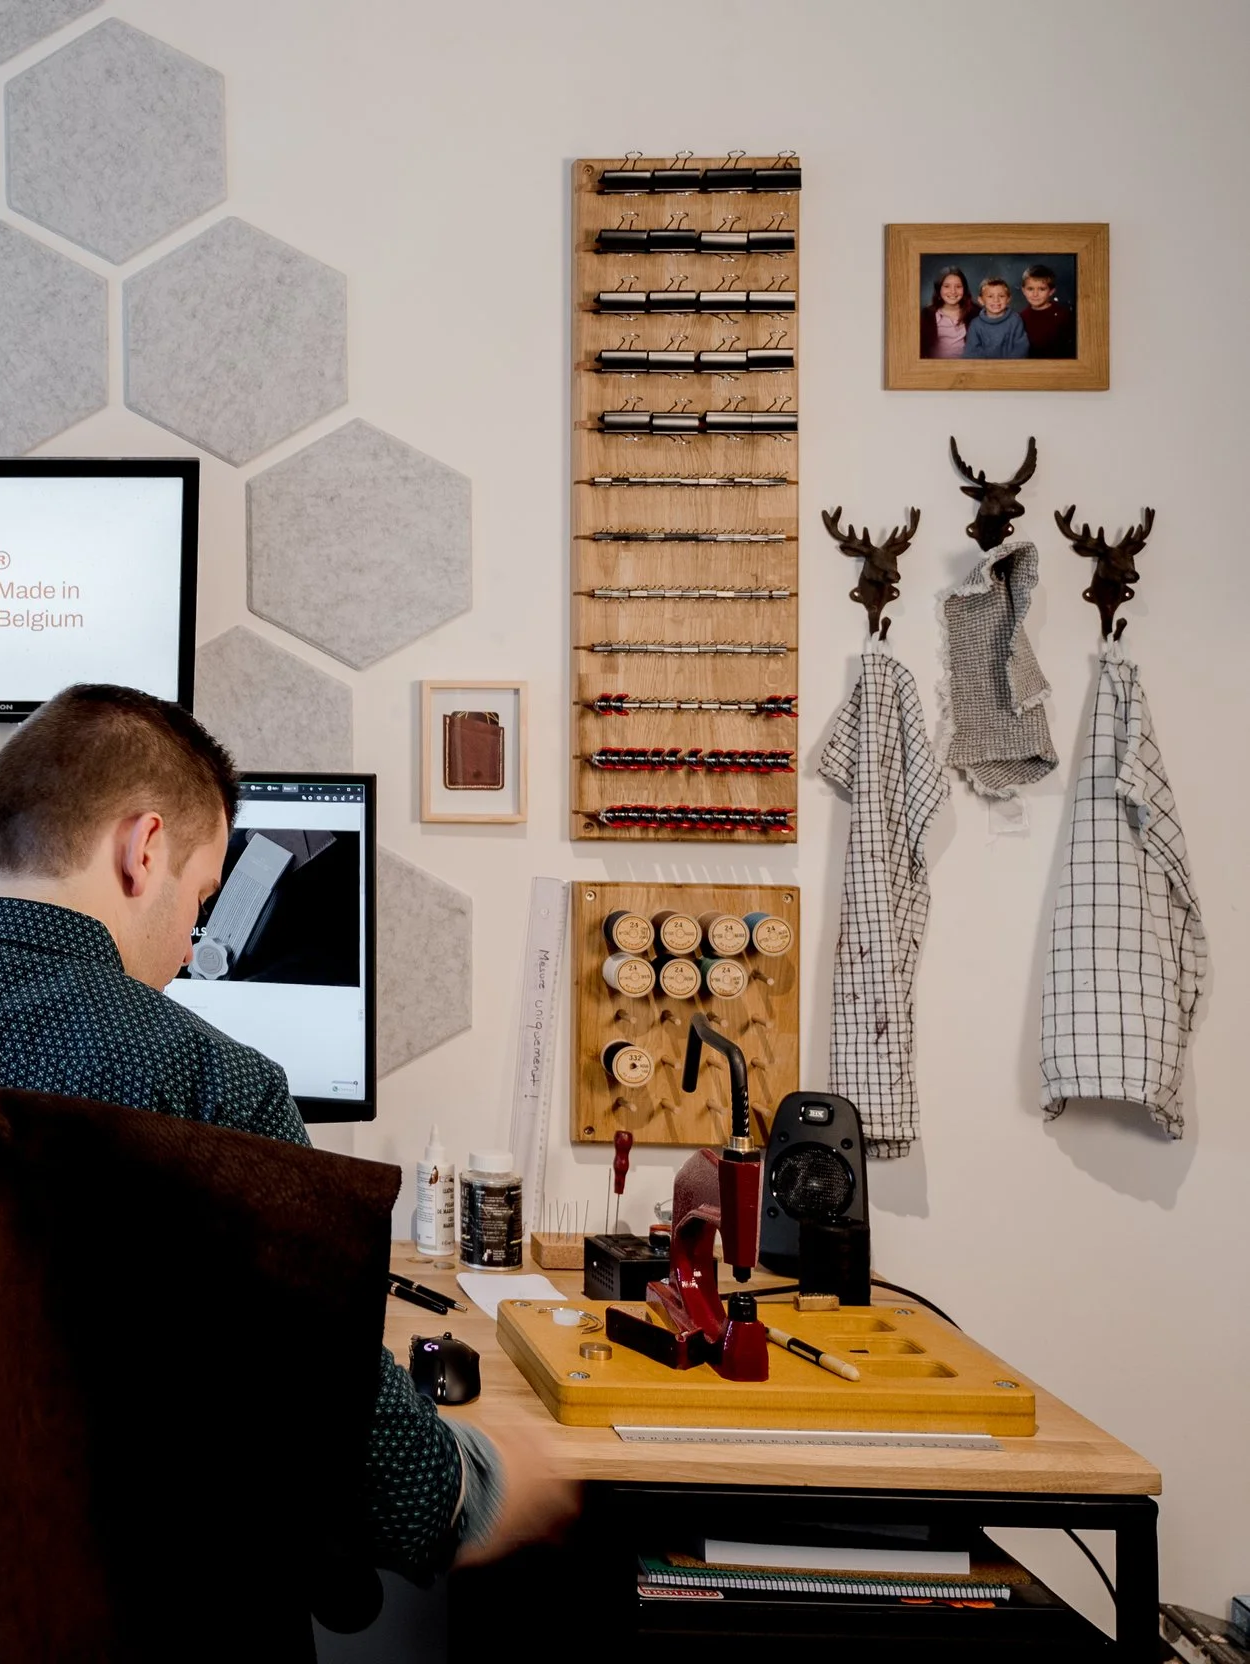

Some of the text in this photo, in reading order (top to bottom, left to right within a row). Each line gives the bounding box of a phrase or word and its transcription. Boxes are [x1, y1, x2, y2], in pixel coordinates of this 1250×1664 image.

[62, 581, 80, 600] in
[538, 949, 550, 990] Mesure
[526, 999, 544, 1086] uniquement
